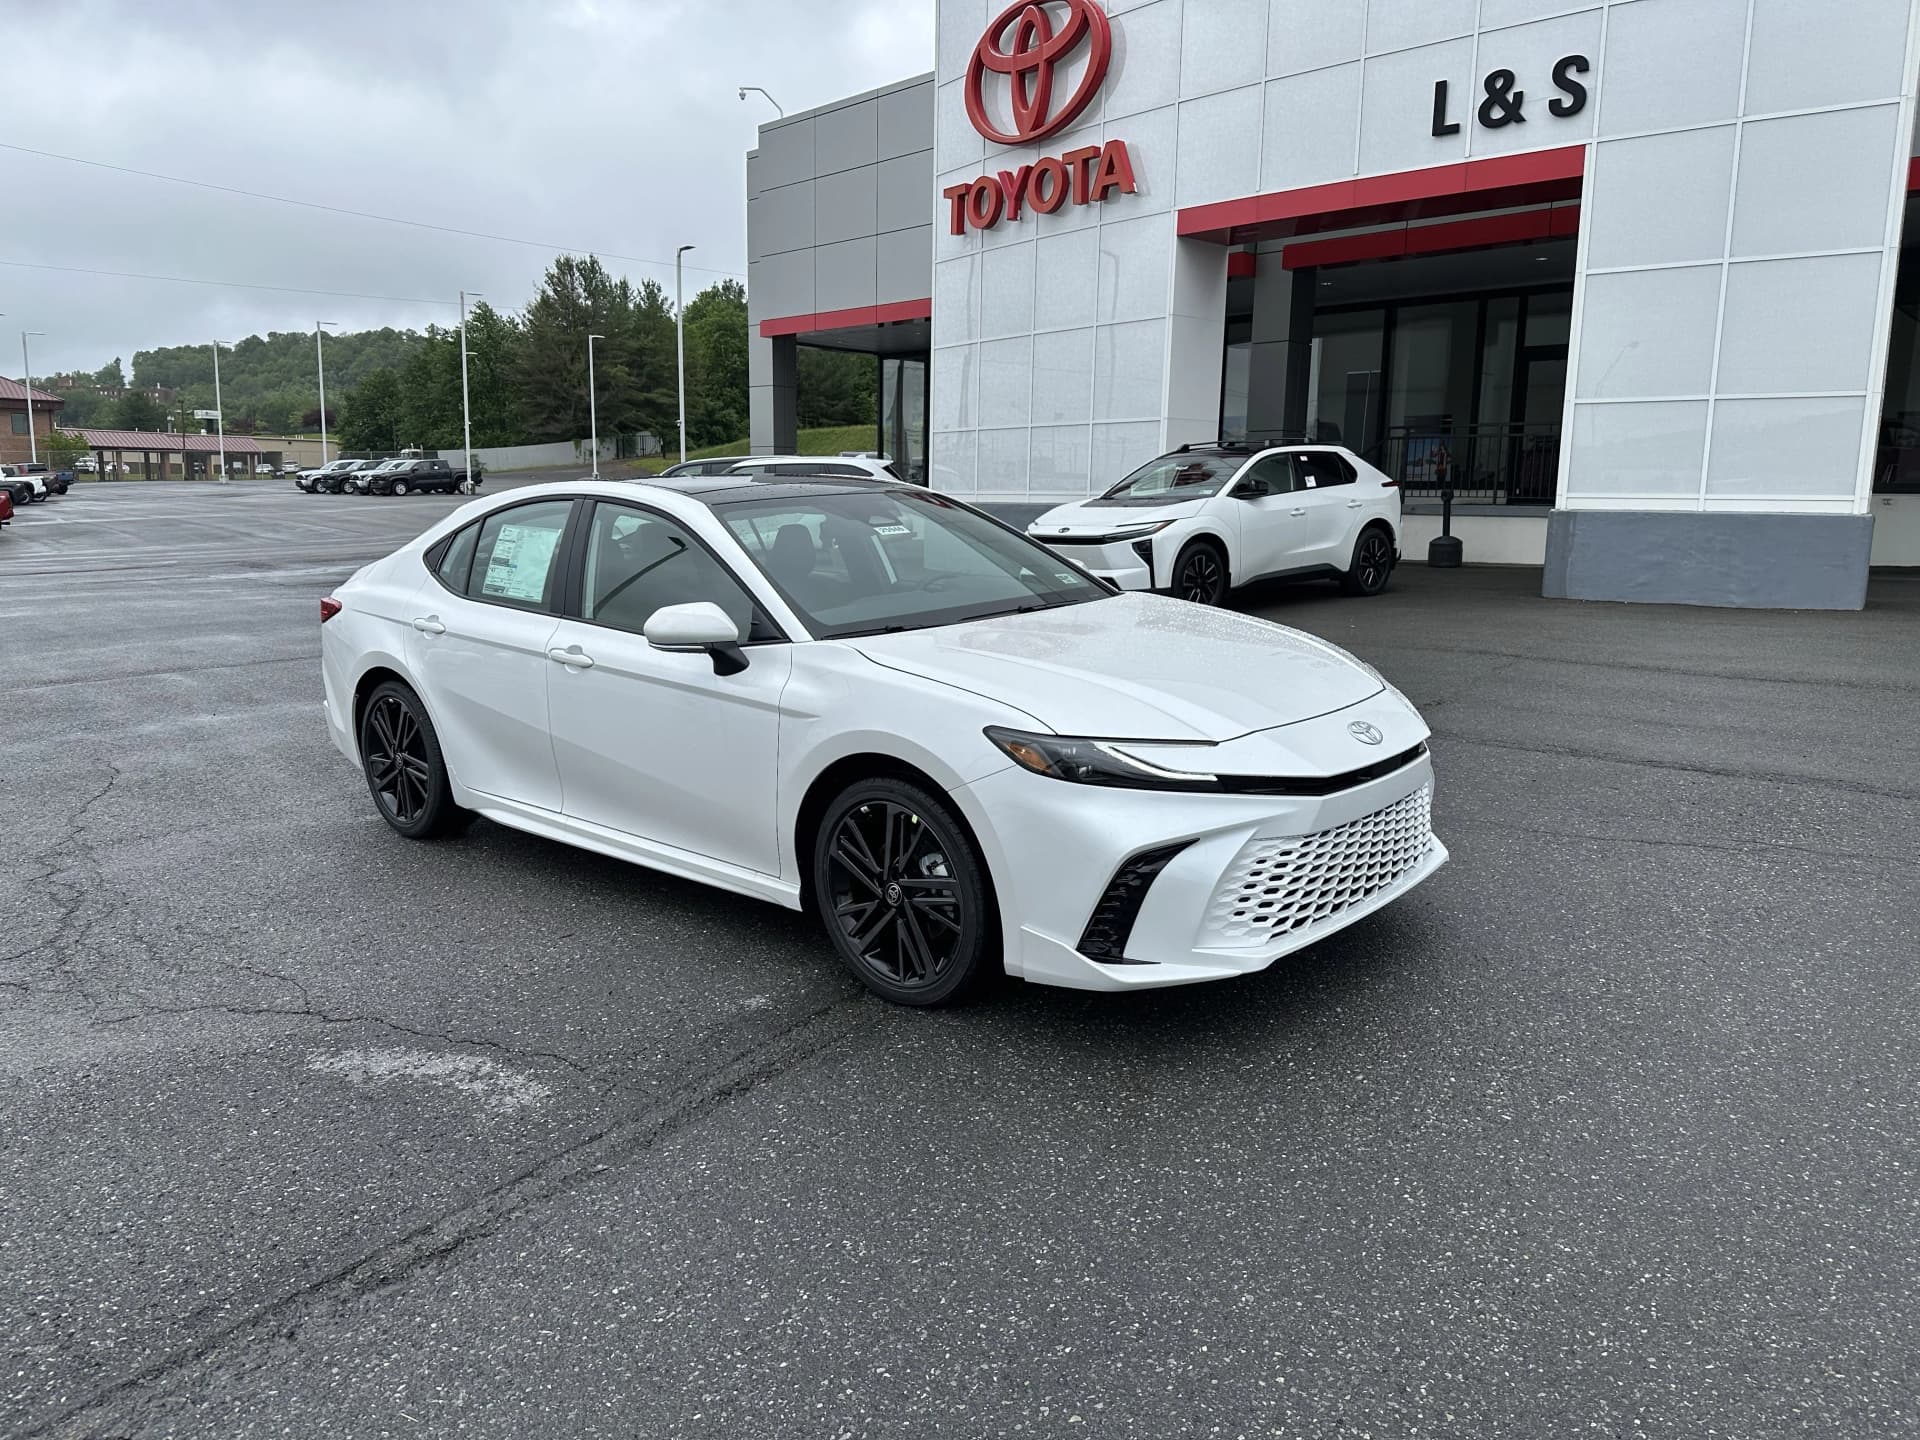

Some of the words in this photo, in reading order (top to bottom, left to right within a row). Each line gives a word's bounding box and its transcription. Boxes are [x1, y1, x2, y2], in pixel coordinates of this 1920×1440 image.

[1432, 80, 1460, 136] L
[1478, 69, 1526, 128] &
[1549, 55, 1589, 117] S
[943, 139, 1138, 235] TOYOTA
